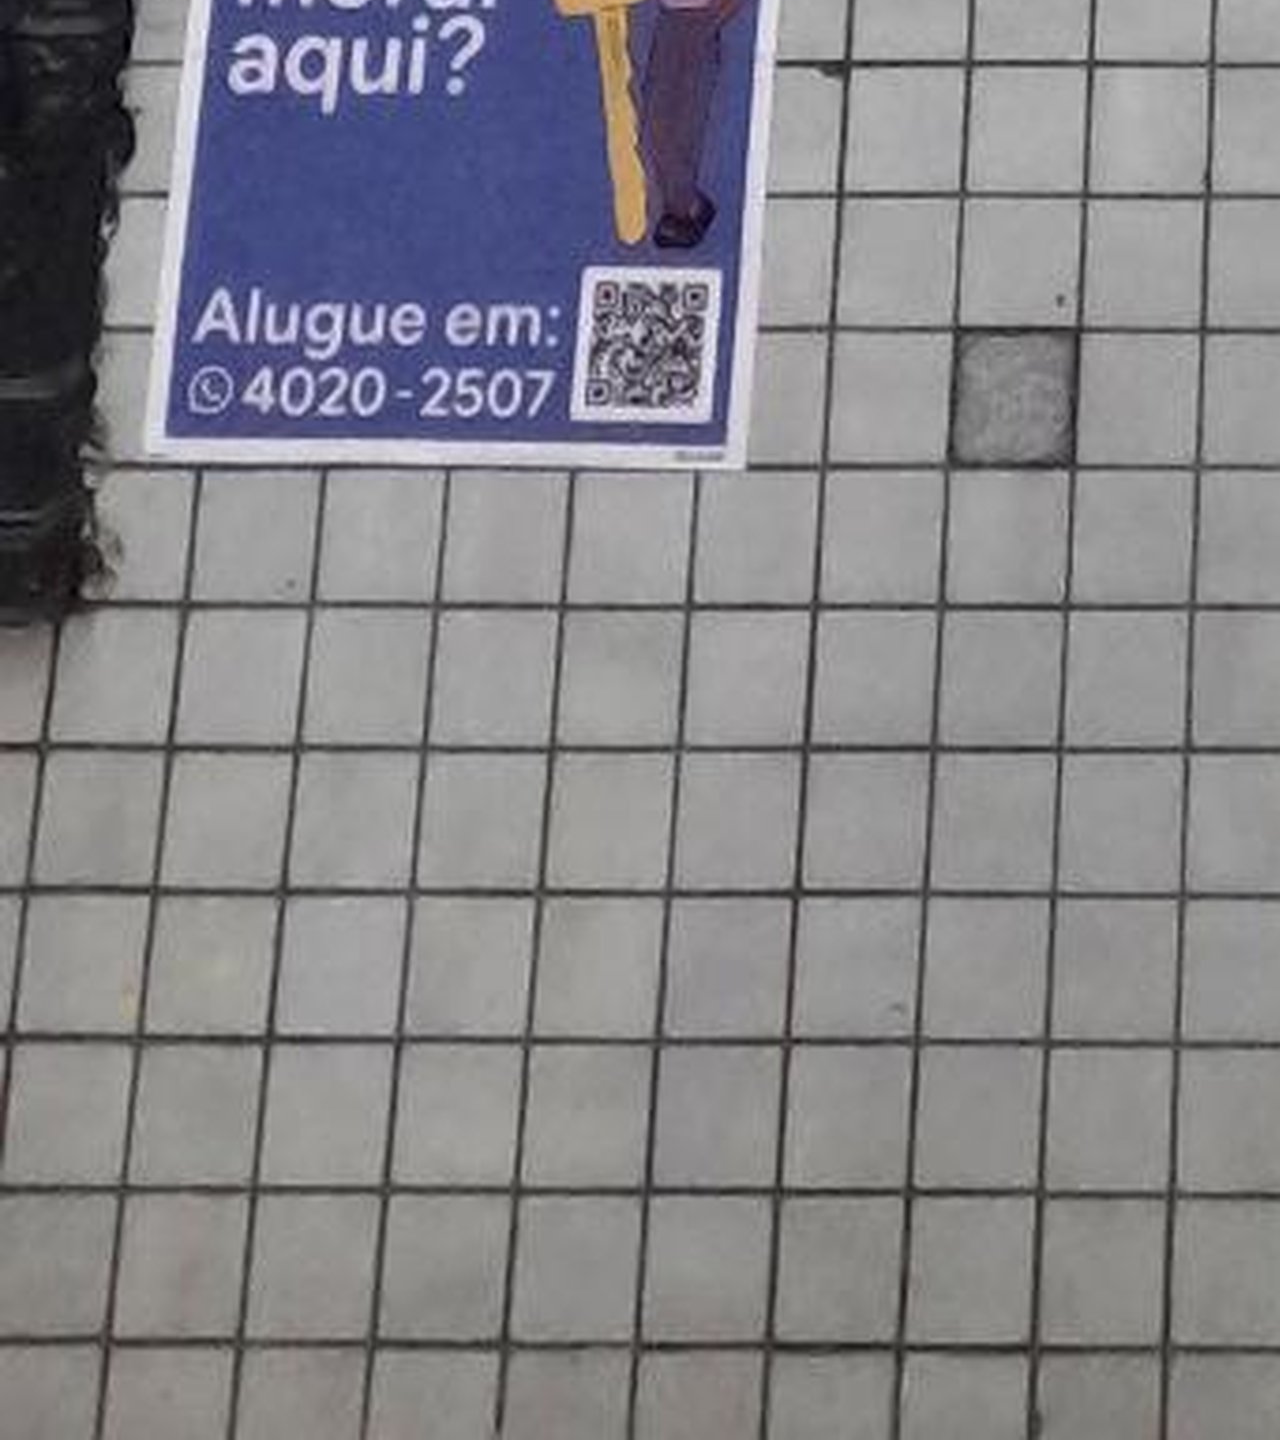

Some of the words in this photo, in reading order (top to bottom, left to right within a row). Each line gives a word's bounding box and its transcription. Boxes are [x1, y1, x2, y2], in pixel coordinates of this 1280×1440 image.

[227, 13, 486, 115] aqui?
[191, 287, 427, 360] Alugue
[444, 301, 562, 348] em:
